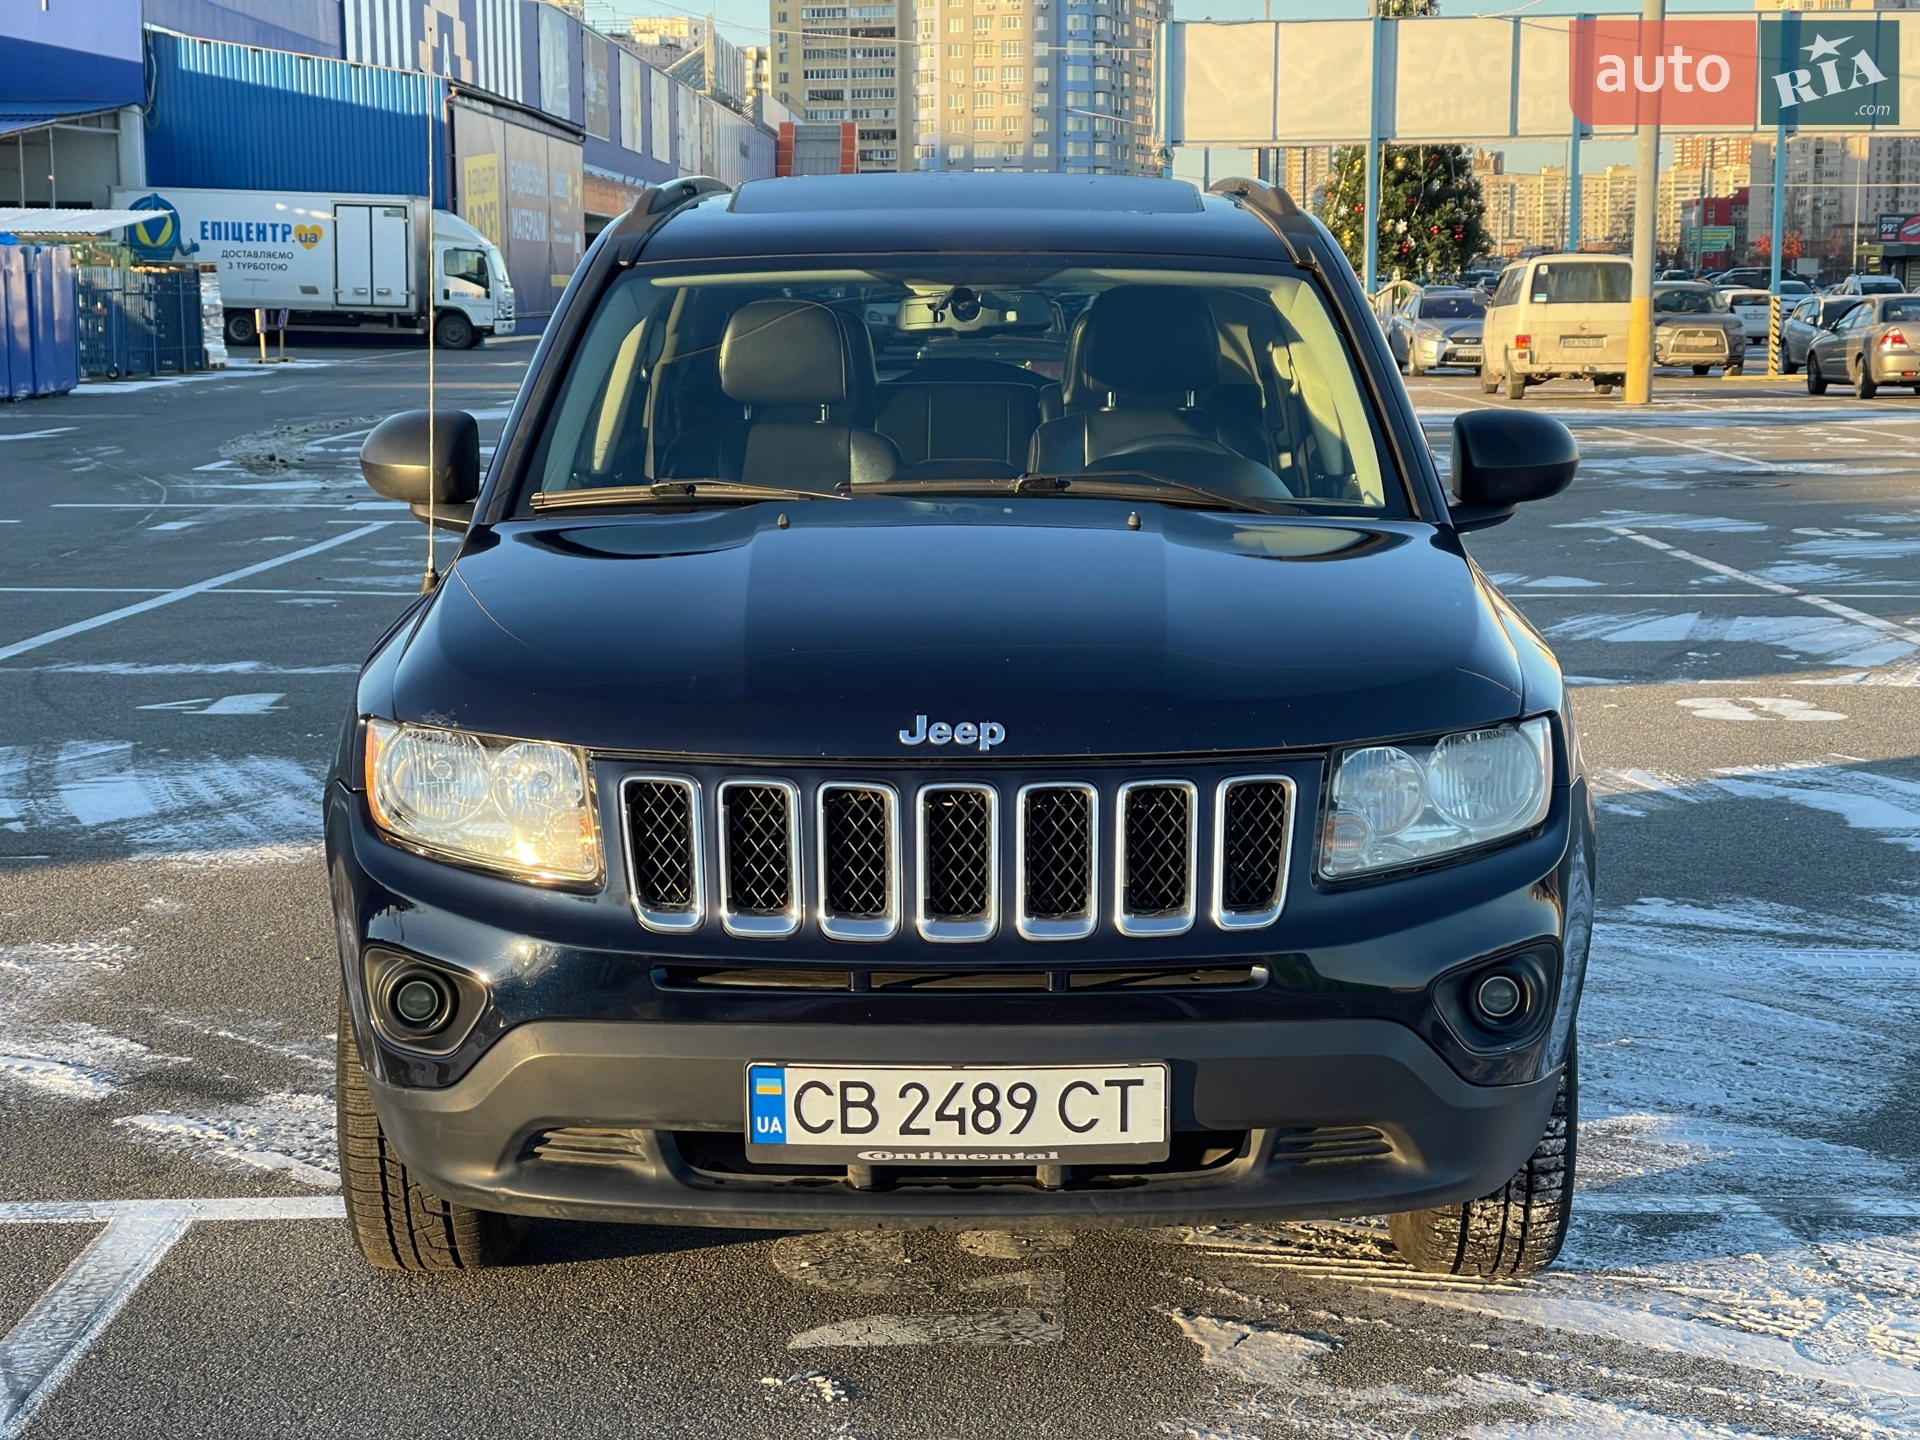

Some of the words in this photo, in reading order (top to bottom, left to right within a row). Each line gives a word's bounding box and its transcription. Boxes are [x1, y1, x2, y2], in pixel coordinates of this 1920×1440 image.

[221, 249, 294, 260] ДОСТАВЛЯЄМО
[236, 261, 288, 271] ТУРБОТОЮ
[899, 714, 1006, 751] Jeep
[793, 1079, 880, 1136] CB
[898, 1081, 1038, 1136] 2489
[1058, 1078, 1145, 1134] CT
[756, 1116, 784, 1134] UA
[857, 1149, 1060, 1162] Continental
